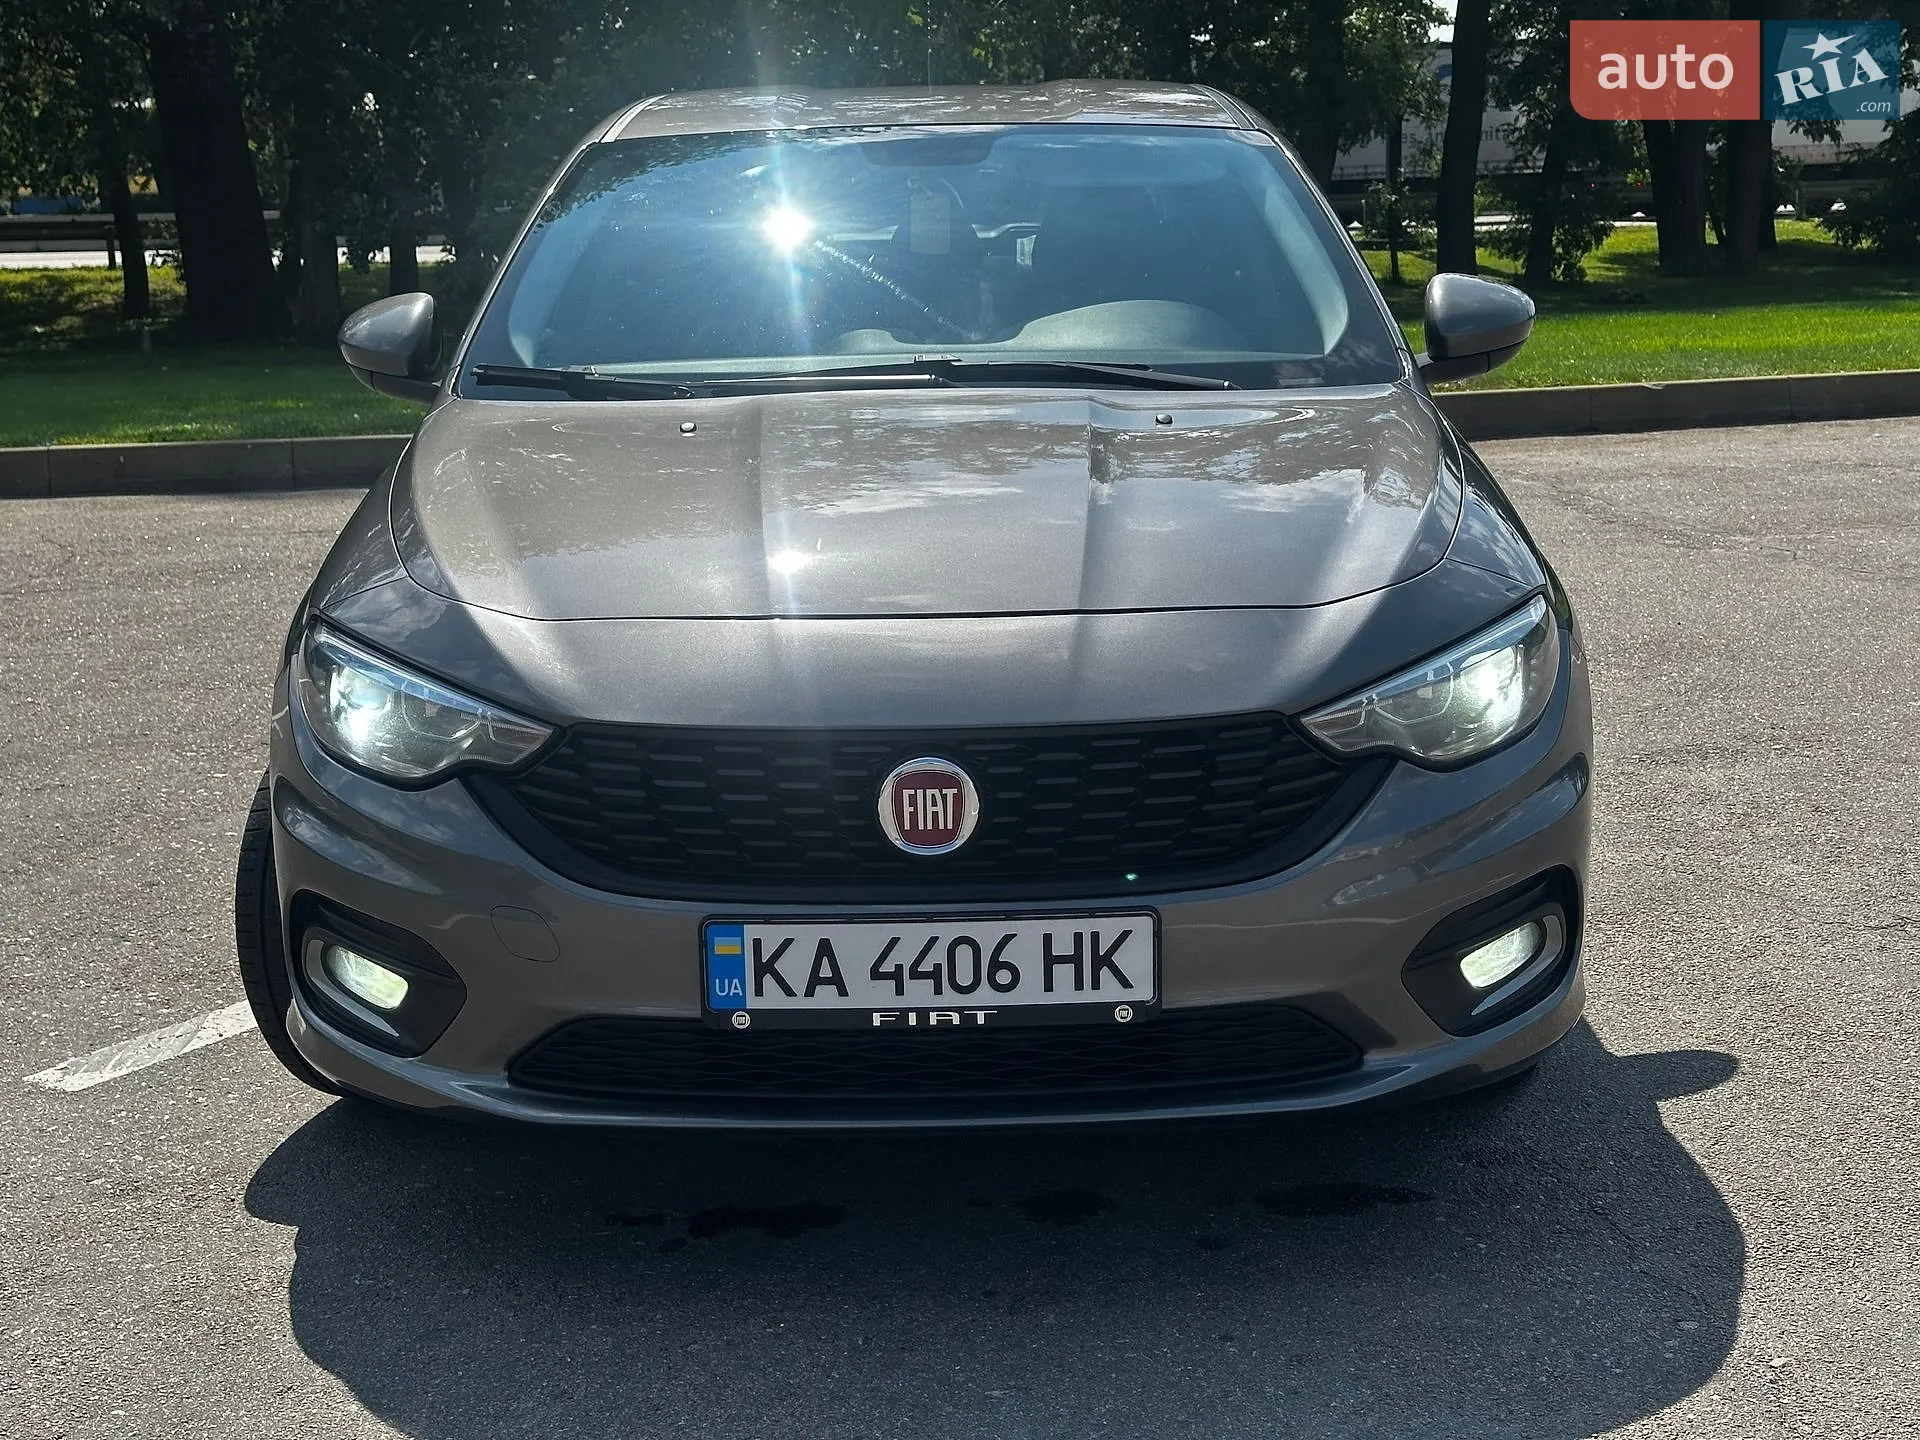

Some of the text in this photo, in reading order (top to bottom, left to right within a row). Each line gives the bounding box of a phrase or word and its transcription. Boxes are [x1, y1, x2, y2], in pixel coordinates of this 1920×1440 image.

[902, 788, 958, 830] FIAT
[752, 929, 1134, 998] KA 4406 HK
[715, 978, 743, 996] UA
[872, 1010, 998, 1027] FIAT
